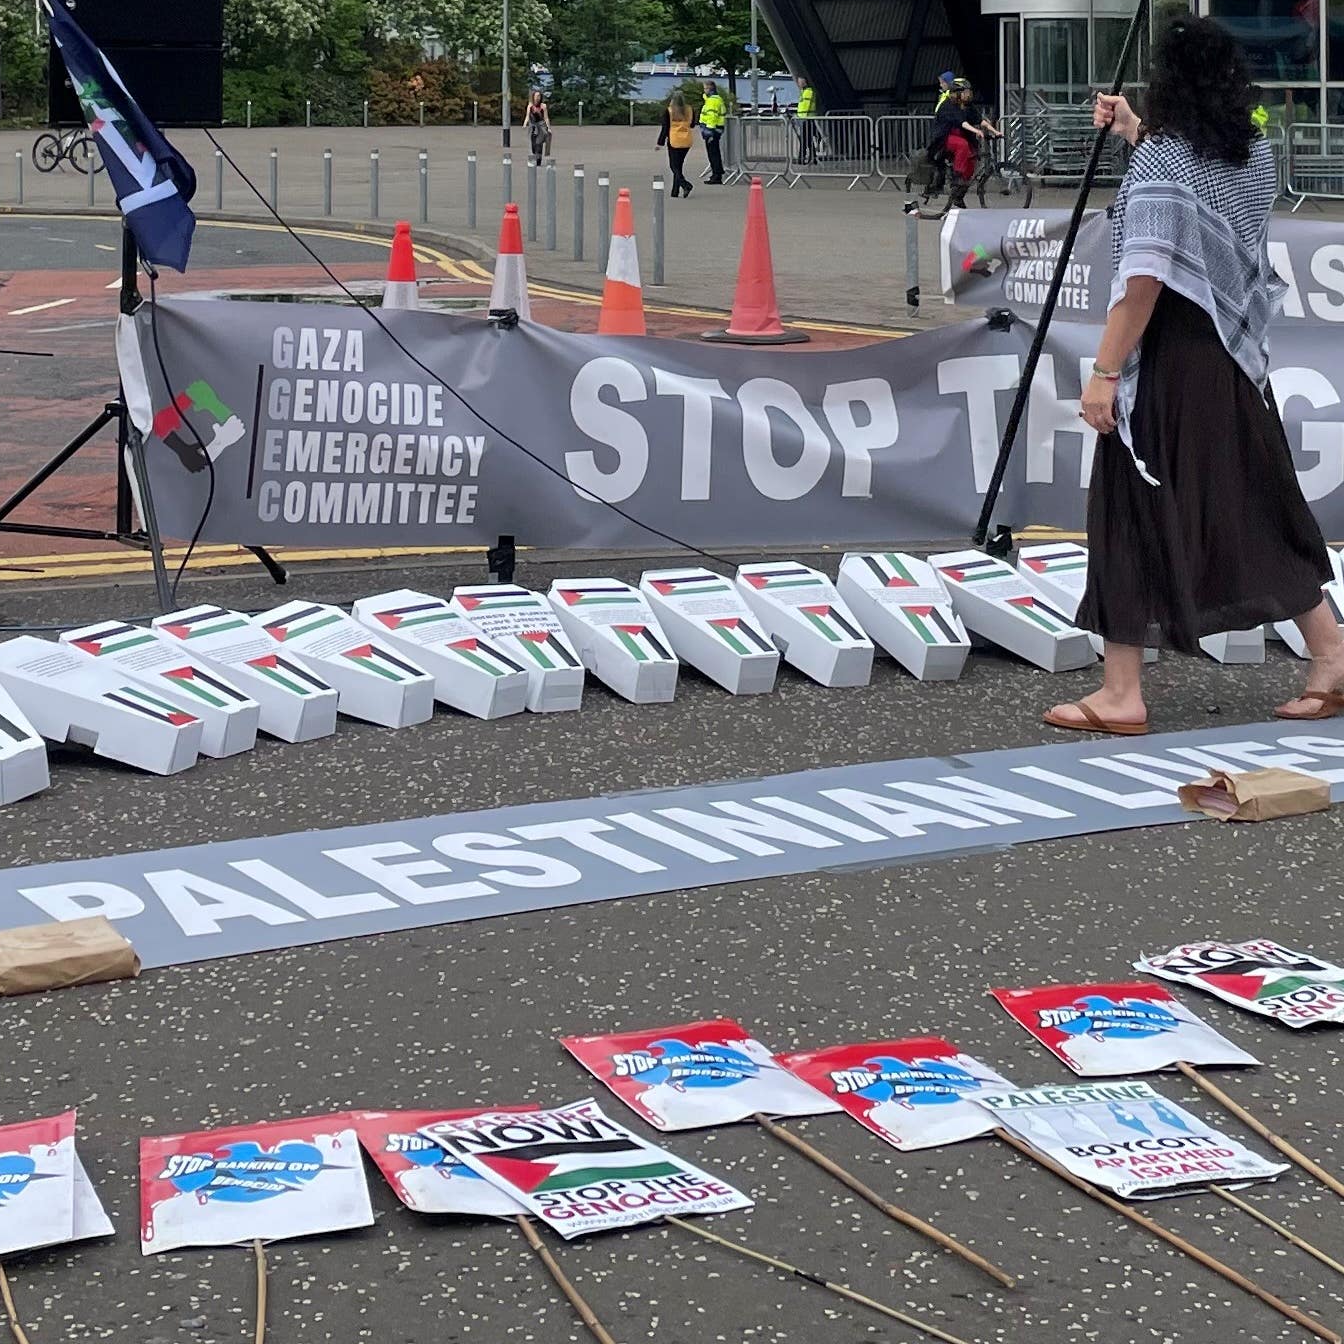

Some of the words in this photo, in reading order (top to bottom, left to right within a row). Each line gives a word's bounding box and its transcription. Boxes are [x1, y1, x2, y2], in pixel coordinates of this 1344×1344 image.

[1007, 219, 1046, 238] GAZA
[1006, 259, 1092, 286] EMERGNCY
[1005, 280, 1090, 310] COMMTTEE
[272, 326, 365, 372] GAZA
[268, 378, 444, 427] GENOCIDE
[565, 355, 900, 505] STOP
[938, 353, 1102, 496] TH
[263, 429, 487, 478] EMERGENCY
[258, 480, 479, 525] COMMITTEE
[18, 765, 1077, 938] PALESTINIAN
[1257, 984, 1330, 1012] STOP
[1039, 1009, 1081, 1028] STOP
[1084, 1009, 1146, 1019] BANKING
[613, 1054, 658, 1076] STOP
[661, 1054, 725, 1067] BANKING
[671, 1068, 744, 1079] GENOCIDE
[830, 1071, 878, 1094] STOP
[982, 1083, 1155, 1109] PALESTINE
[426, 1106, 594, 1136] CEASEFIRE
[386, 1133, 435, 1152] STOP
[438, 1119, 631, 1155] NOW!
[1065, 1136, 1221, 1158] BOYCOTT
[159, 1155, 214, 1179] STOP
[215, 1160, 288, 1172] BANKING
[288, 1161, 321, 1172] ON
[1093, 1147, 1235, 1170] APARTHEID
[1127, 1160, 1234, 1181] ISRAEL
[210, 1175, 286, 1193] GENOCIDE
[532, 1180, 629, 1208] STOP
[631, 1172, 704, 1194] THE
[543, 1183, 733, 1220] GENOCIDE
